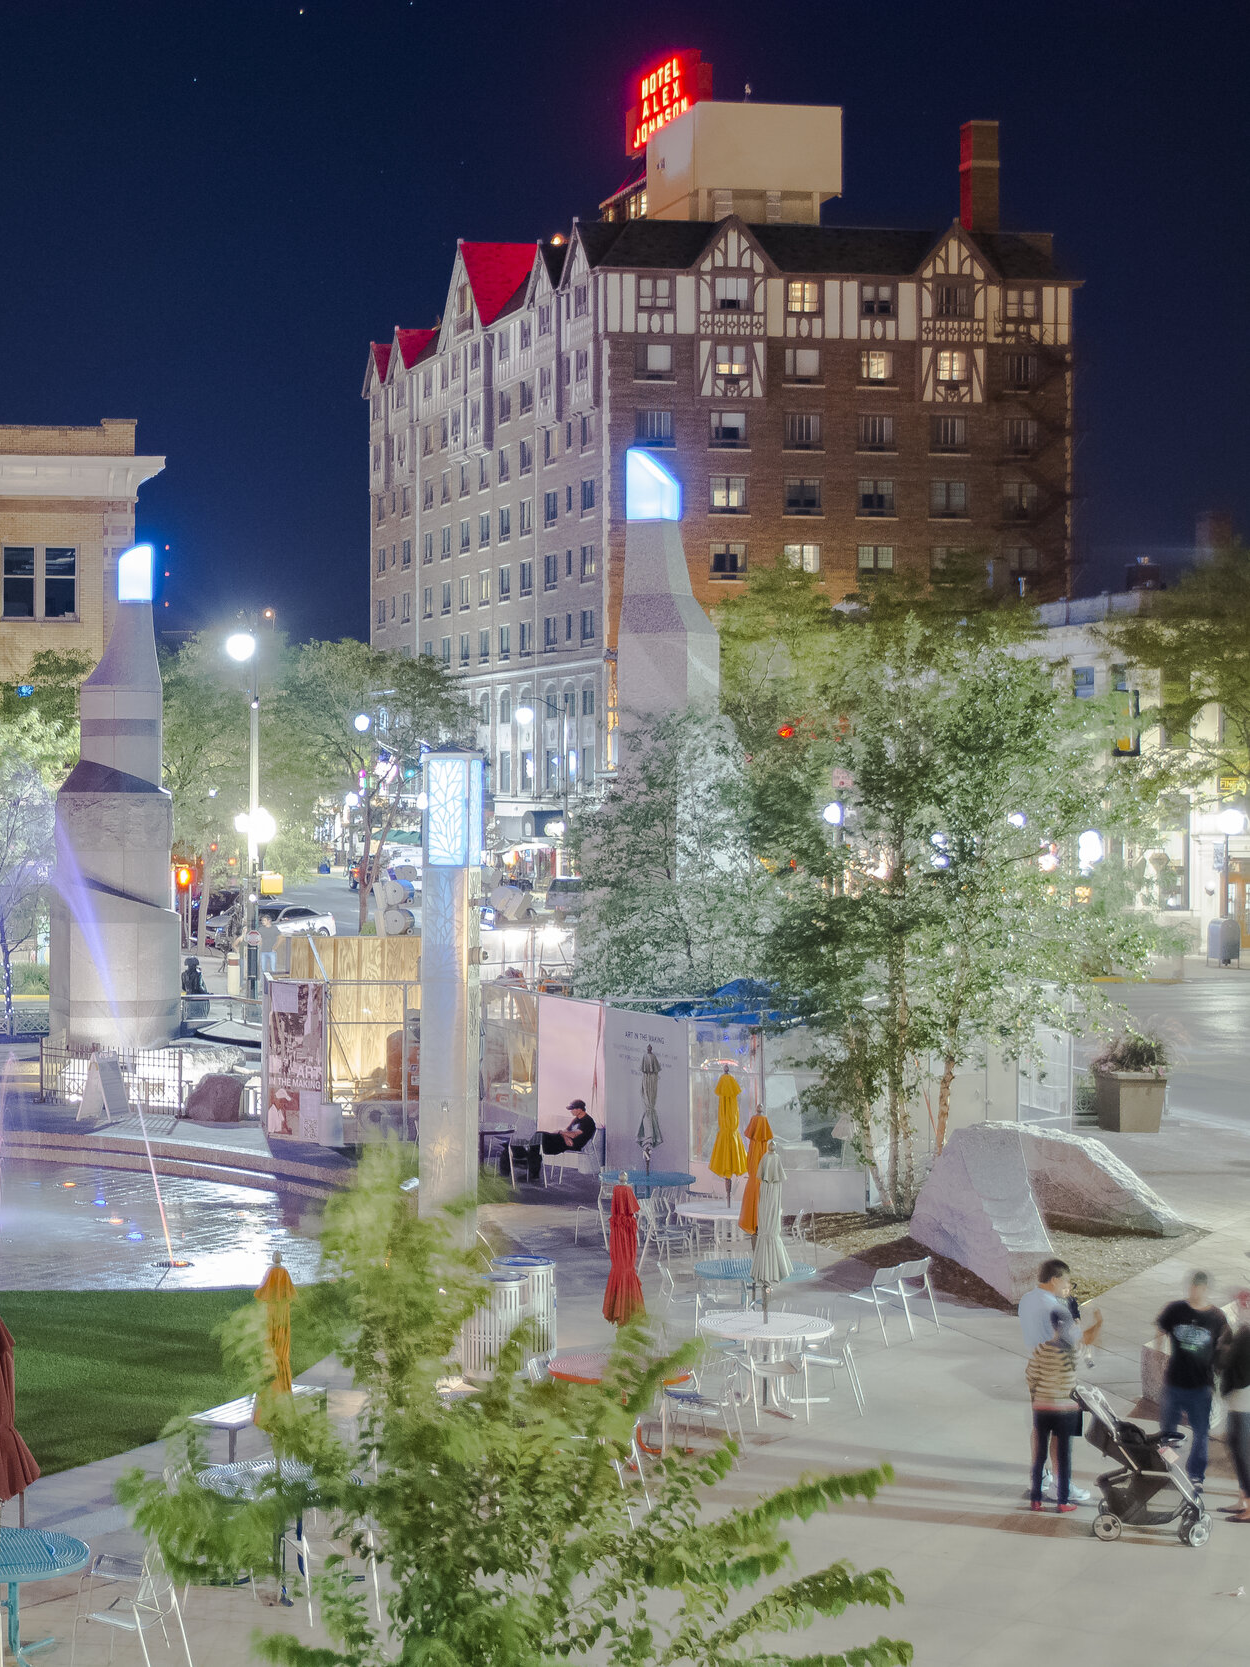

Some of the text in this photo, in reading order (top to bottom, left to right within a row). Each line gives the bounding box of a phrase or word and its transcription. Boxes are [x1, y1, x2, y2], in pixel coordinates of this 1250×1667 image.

[641, 57, 680, 100] HOTEL
[642, 79, 679, 120] ALEX
[633, 96, 688, 149] JOHNSON
[277, 1077, 291, 1087] THE
[292, 1079, 321, 1090] MAKING
